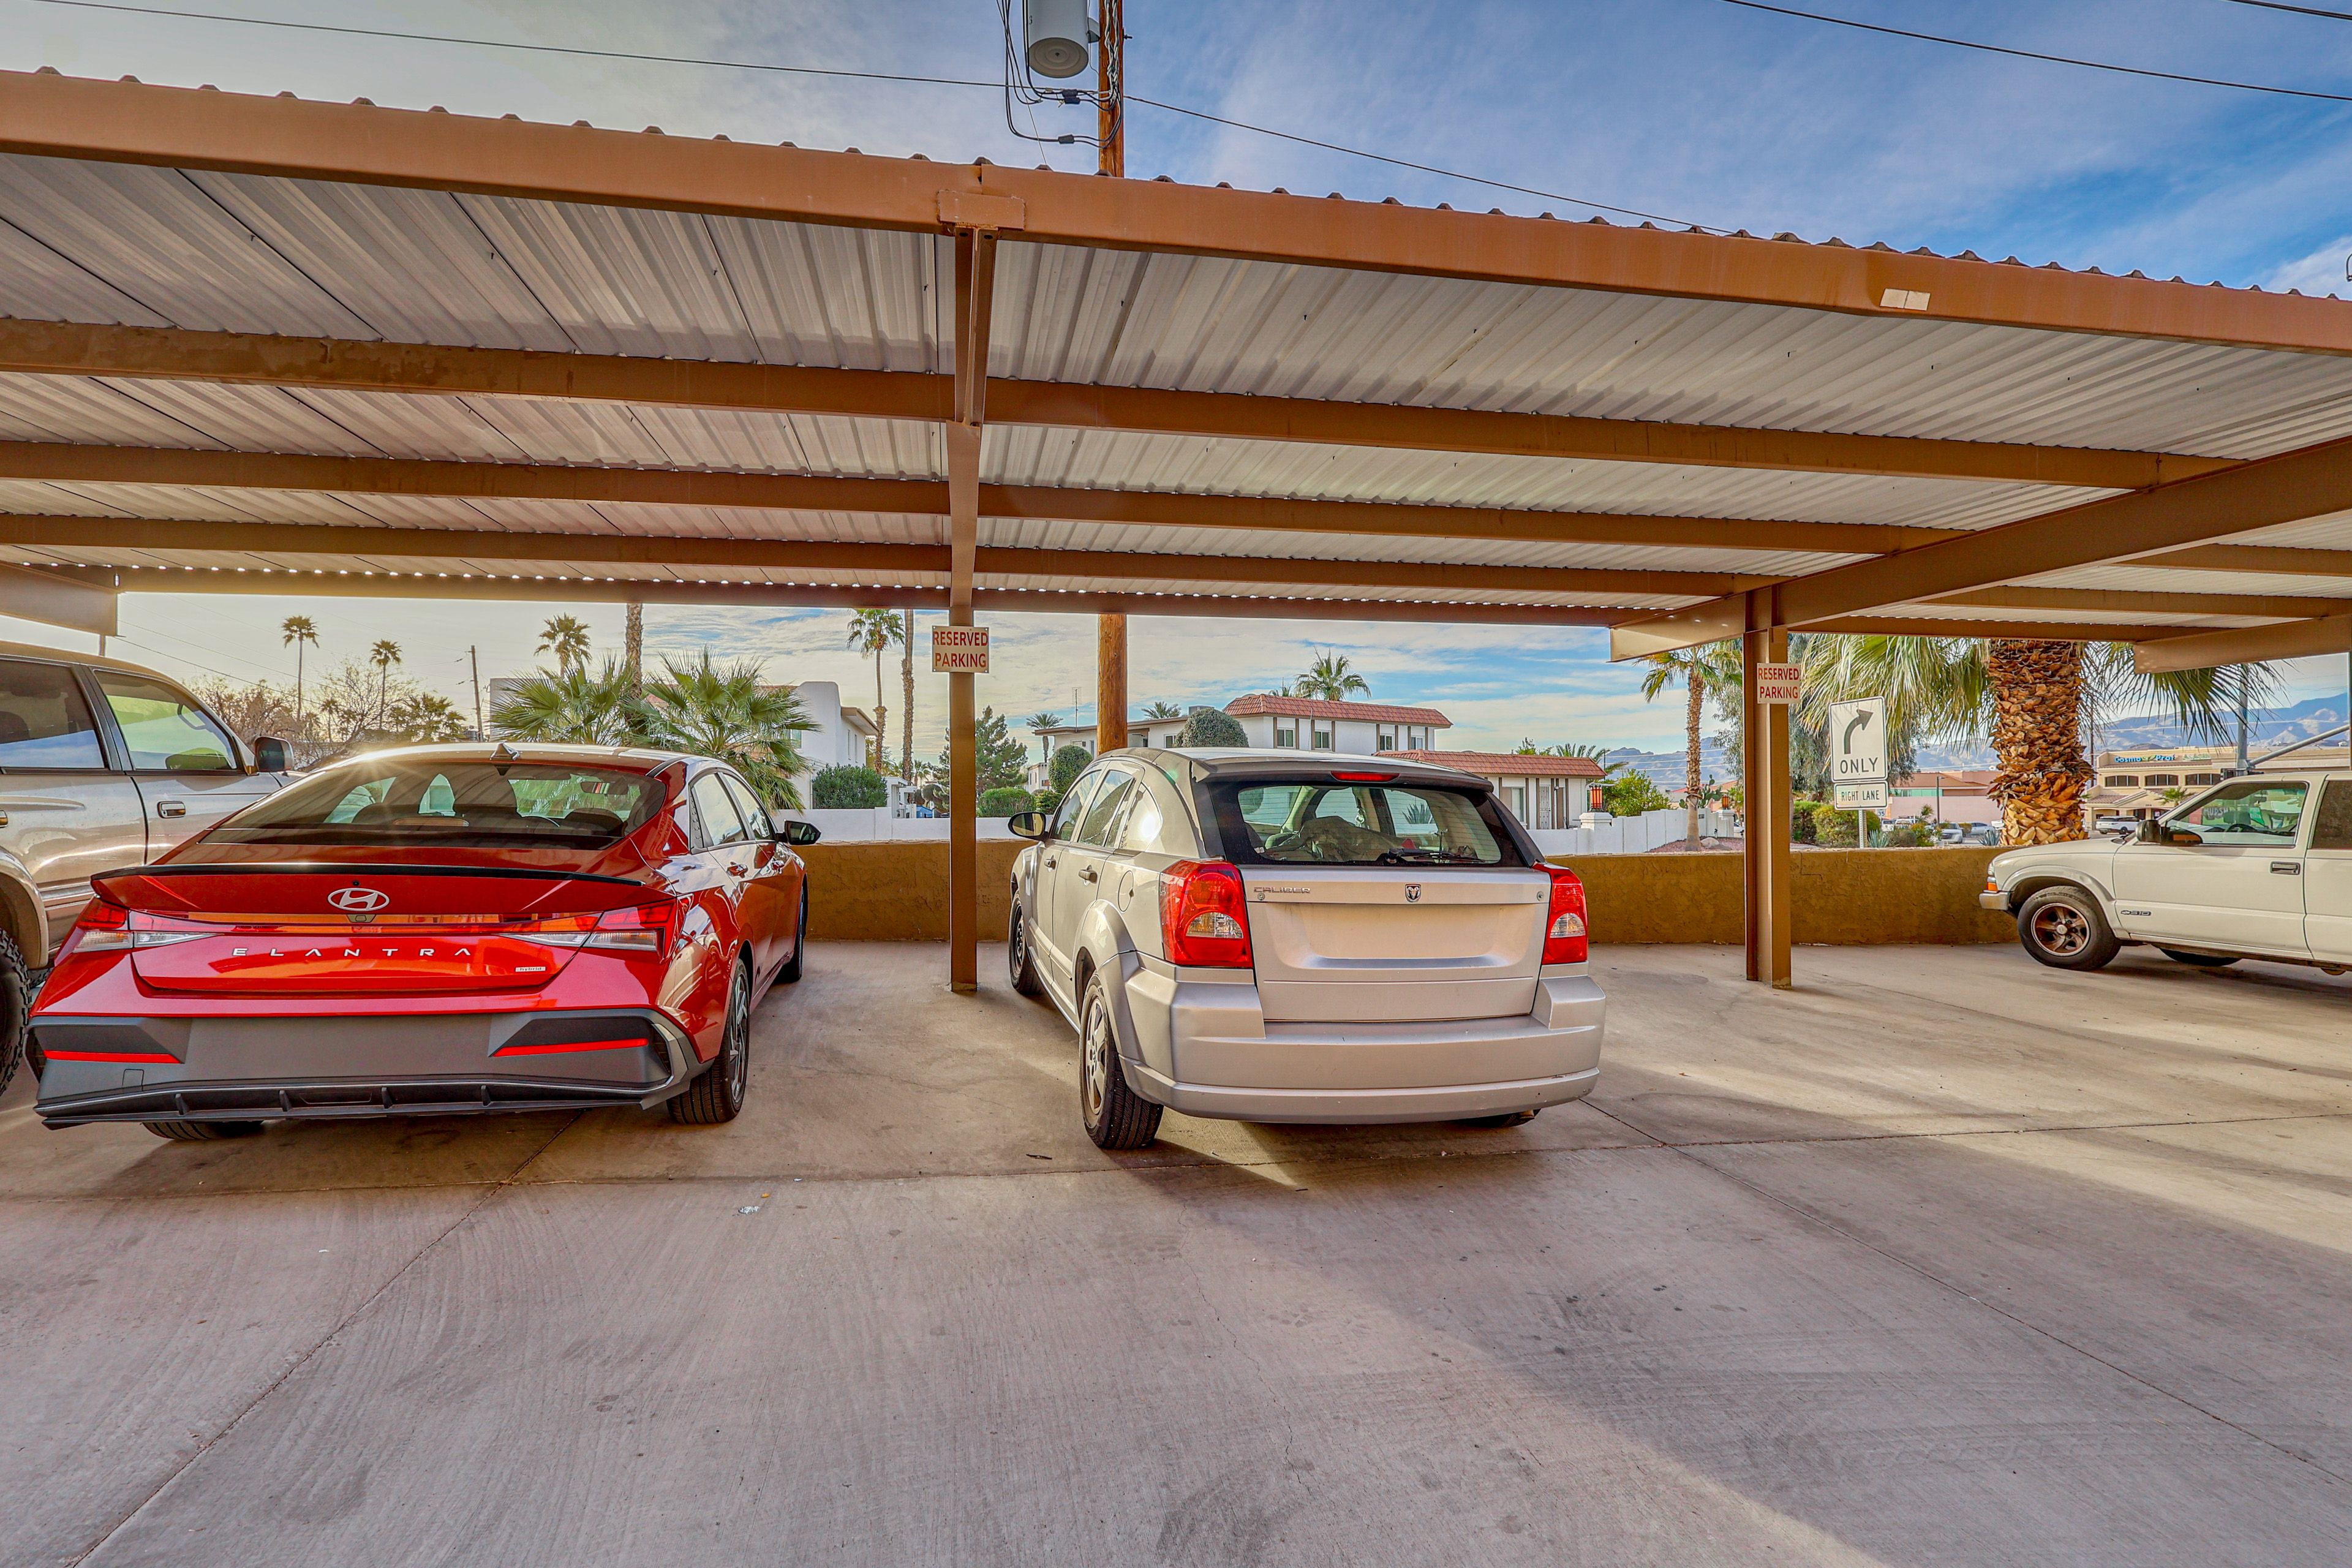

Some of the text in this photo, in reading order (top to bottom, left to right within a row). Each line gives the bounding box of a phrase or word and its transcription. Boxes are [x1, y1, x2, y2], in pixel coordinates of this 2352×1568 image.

[932, 631, 989, 646] RESERVED
[935, 652, 987, 668] PARKING
[1758, 667, 1800, 680] RESERVED
[1760, 685, 1798, 699] PARKING
[1840, 756, 1879, 774] ONLY
[1841, 789, 1880, 801] RIGHT LANE
[232, 948, 471, 957] ELANTRA
